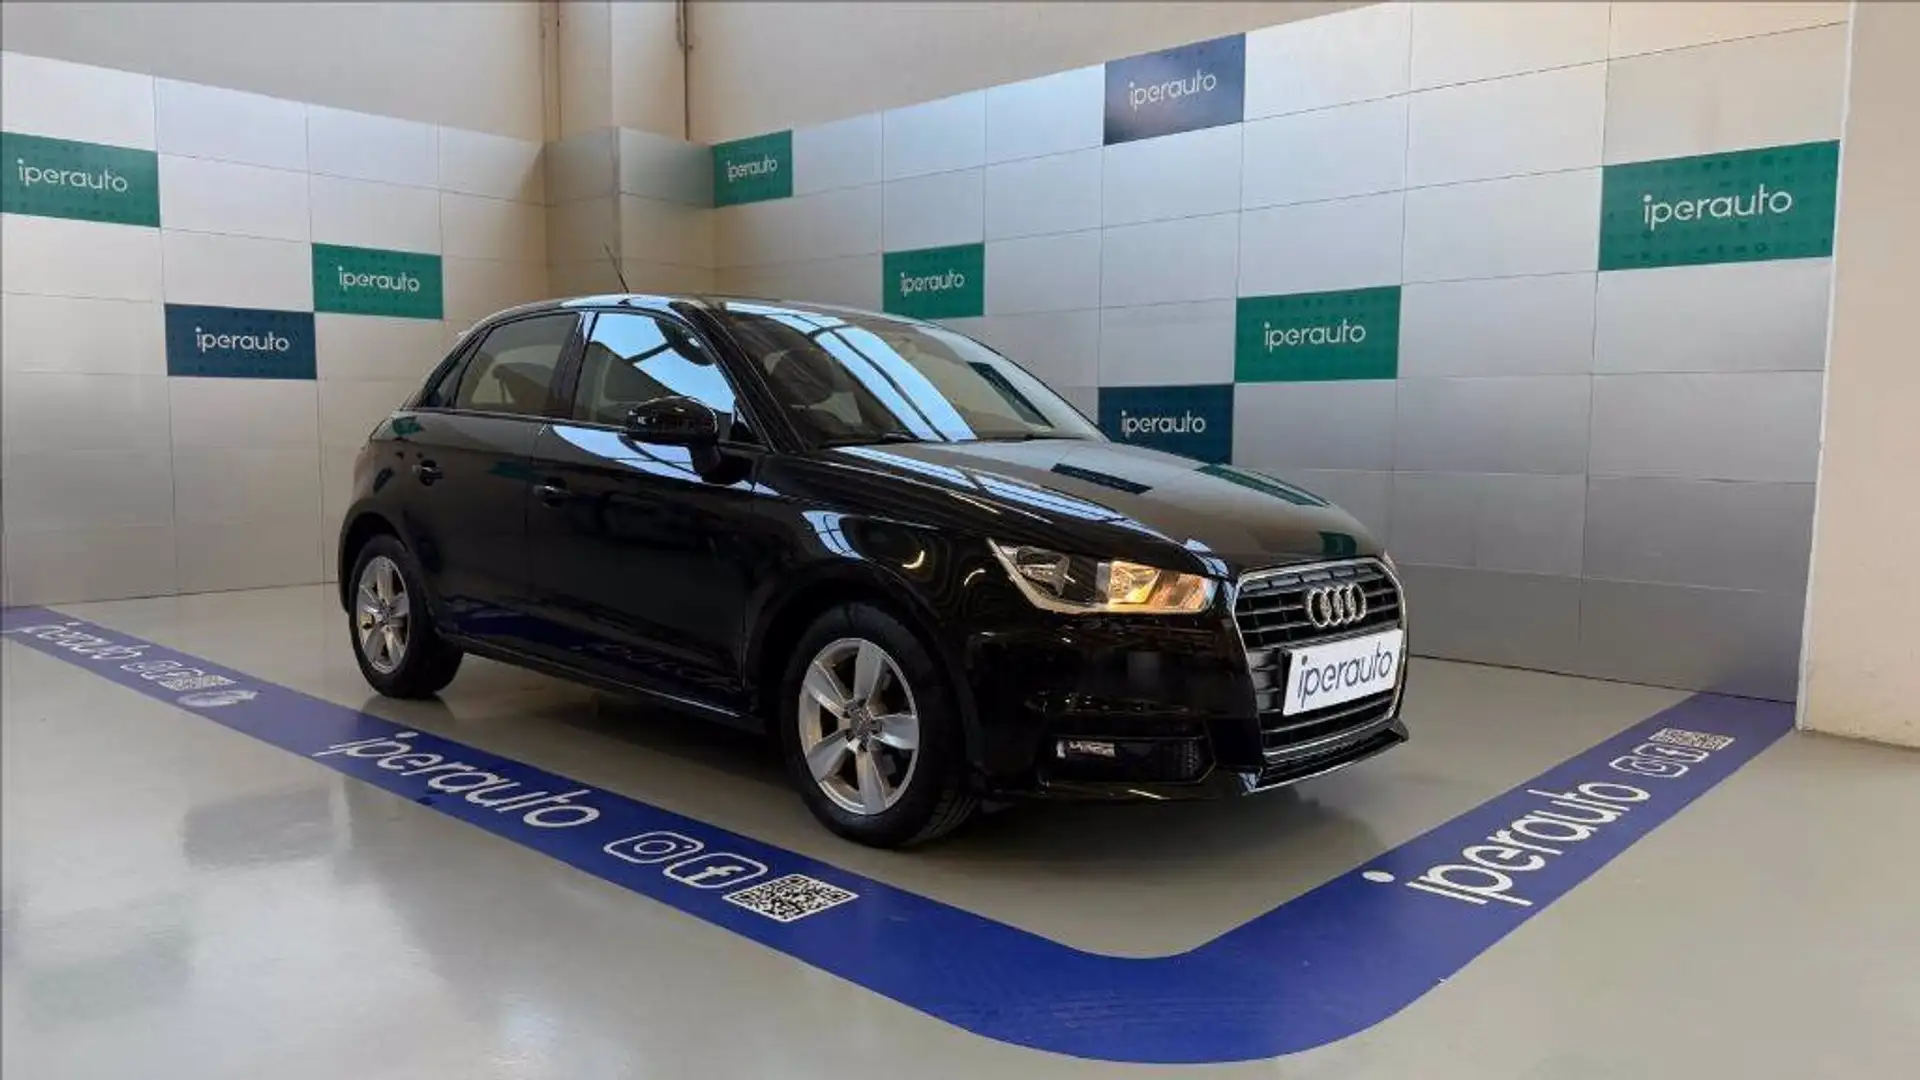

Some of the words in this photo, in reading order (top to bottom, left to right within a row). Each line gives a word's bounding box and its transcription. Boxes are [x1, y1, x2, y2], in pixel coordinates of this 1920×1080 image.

[1129, 69, 1217, 110] iperauto
[17, 159, 129, 194] iperauto
[727, 157, 778, 182] iperauto
[1643, 183, 1793, 231] iperauto
[338, 265, 420, 293] iperauto
[901, 268, 965, 294] iperauto
[195, 326, 290, 356] iperauto
[1264, 318, 1366, 352] iperauto
[1121, 410, 1206, 436] iperauto
[1297, 641, 1393, 709] iperauto
[312, 731, 600, 828] iperauto
[1361, 782, 1651, 907] iperauto
